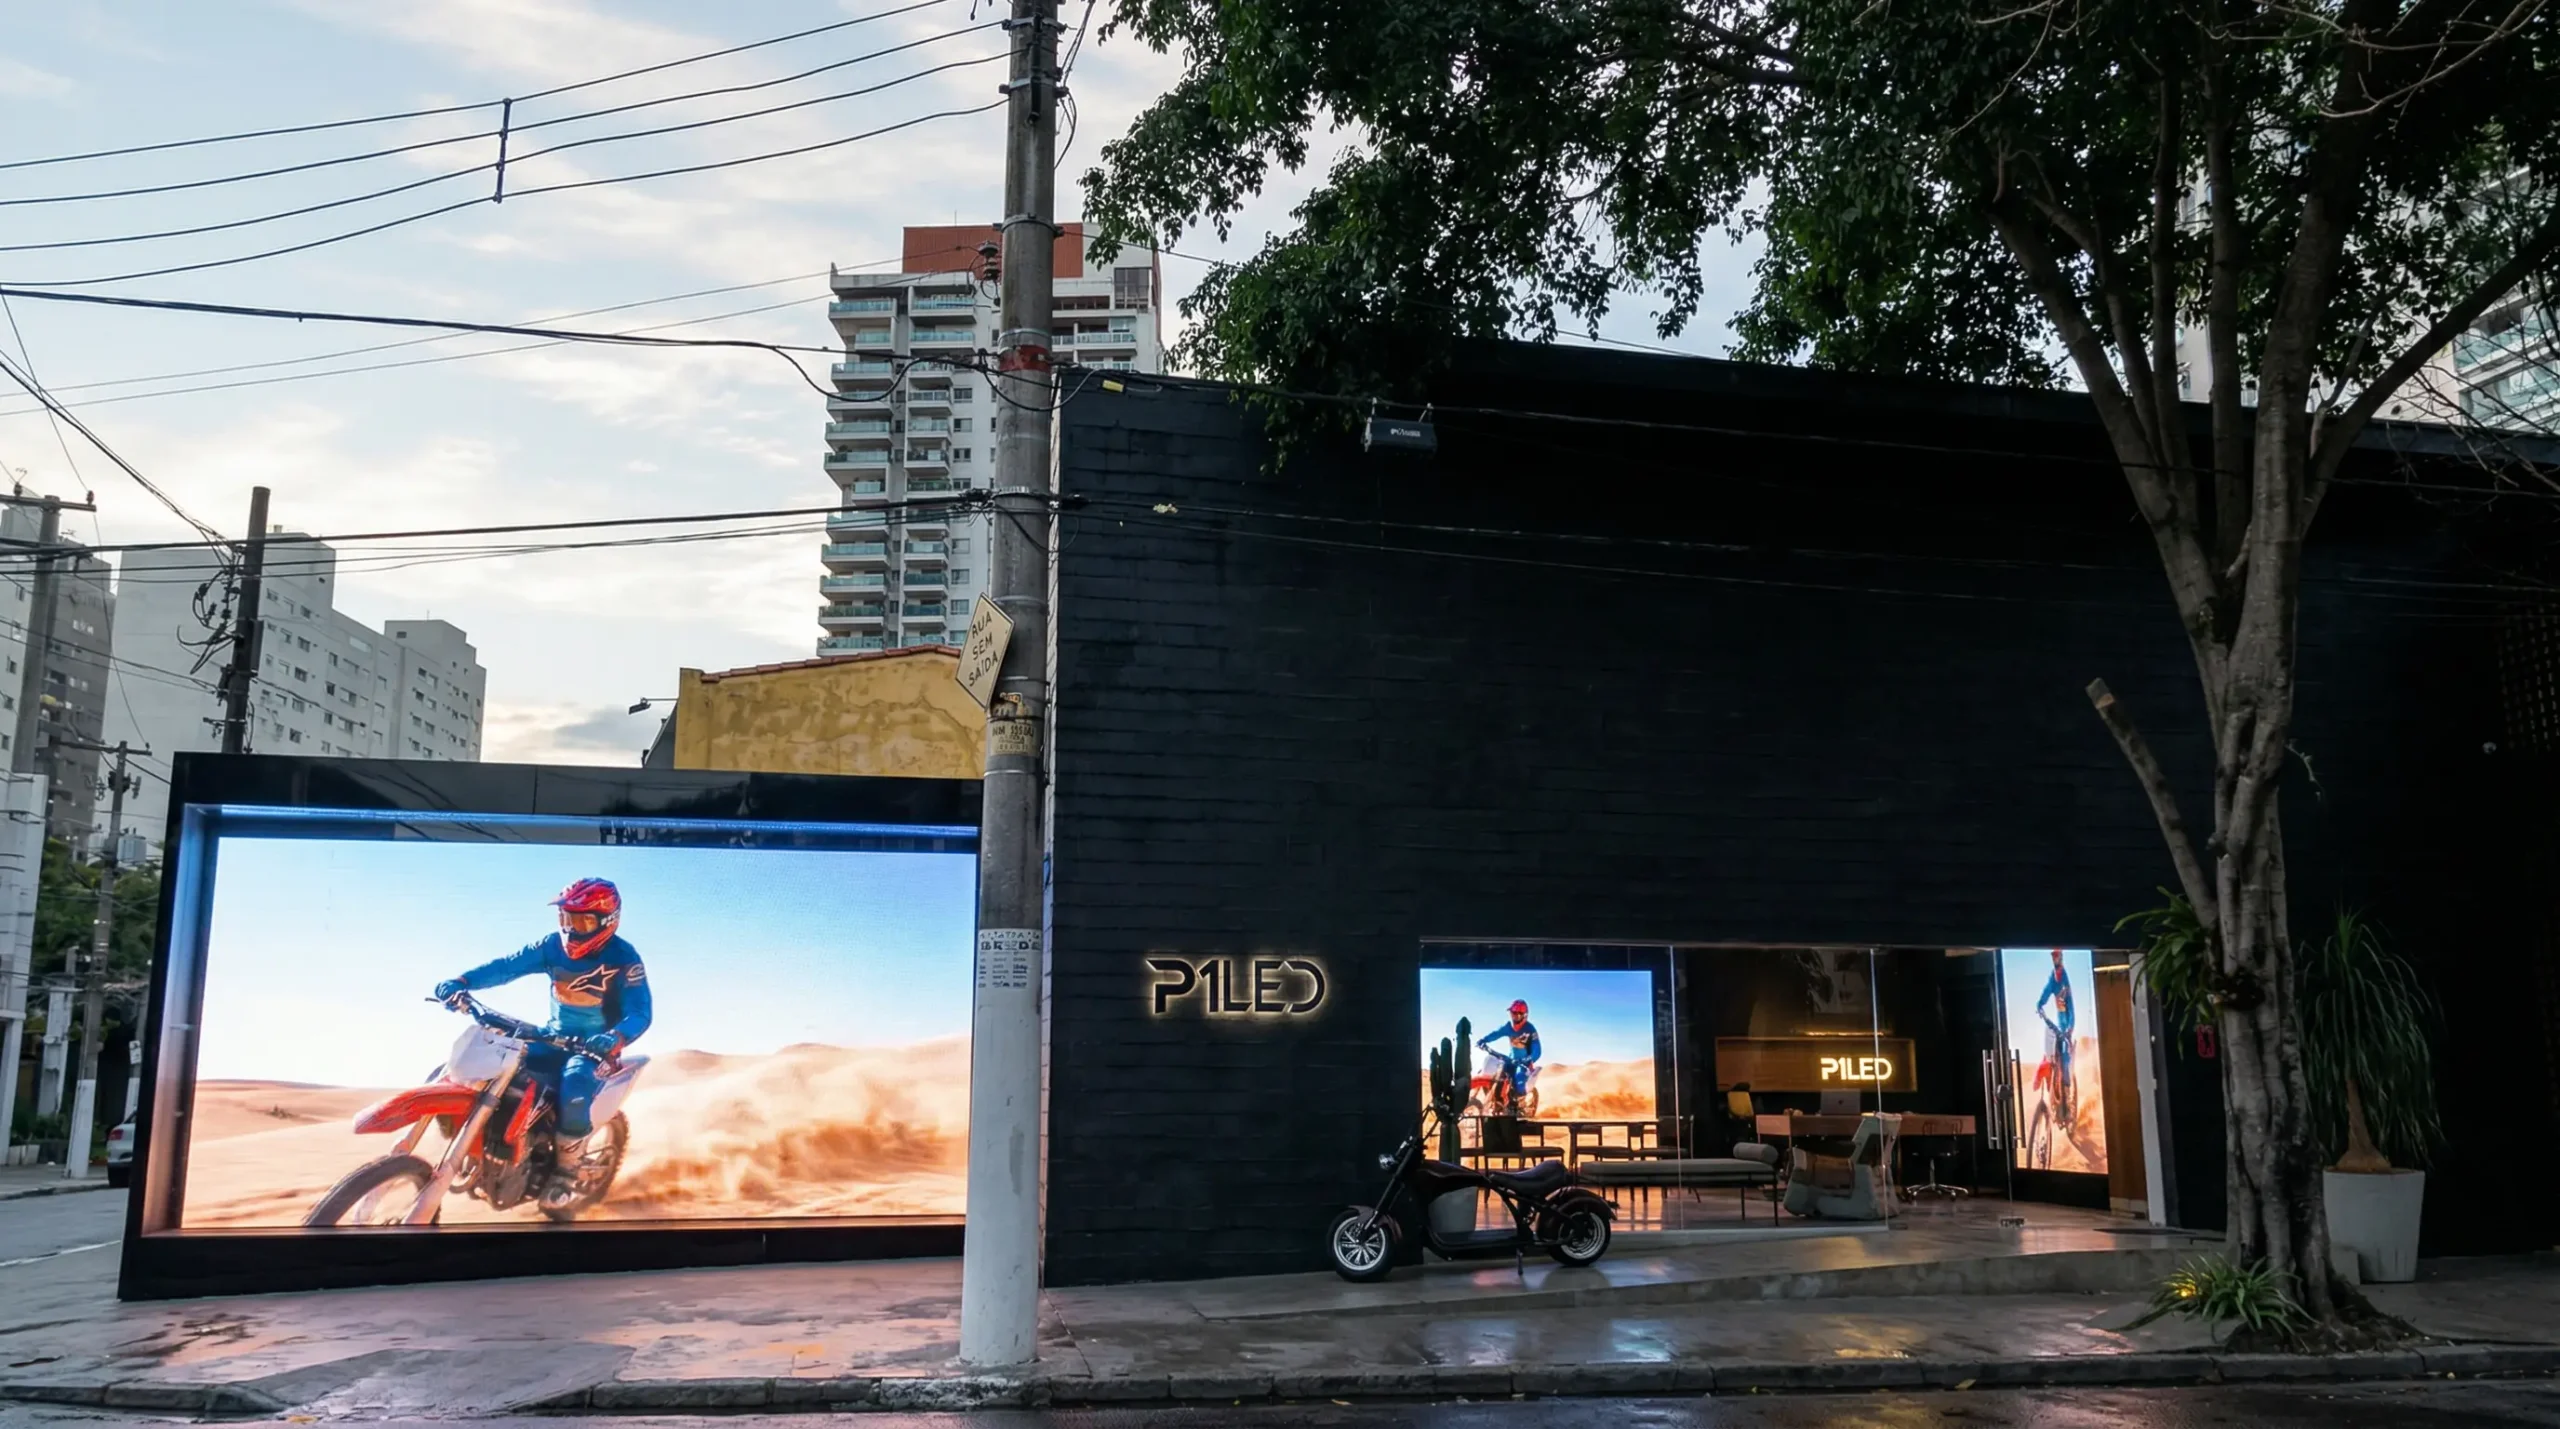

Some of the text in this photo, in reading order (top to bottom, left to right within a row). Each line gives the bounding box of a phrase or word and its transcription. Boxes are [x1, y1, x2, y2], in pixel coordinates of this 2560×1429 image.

[972, 611, 992, 639] RUA
[972, 632, 992, 660] SEM
[1146, 958, 1326, 1014] P1LED
[1820, 1056, 1893, 1081] P1LED
